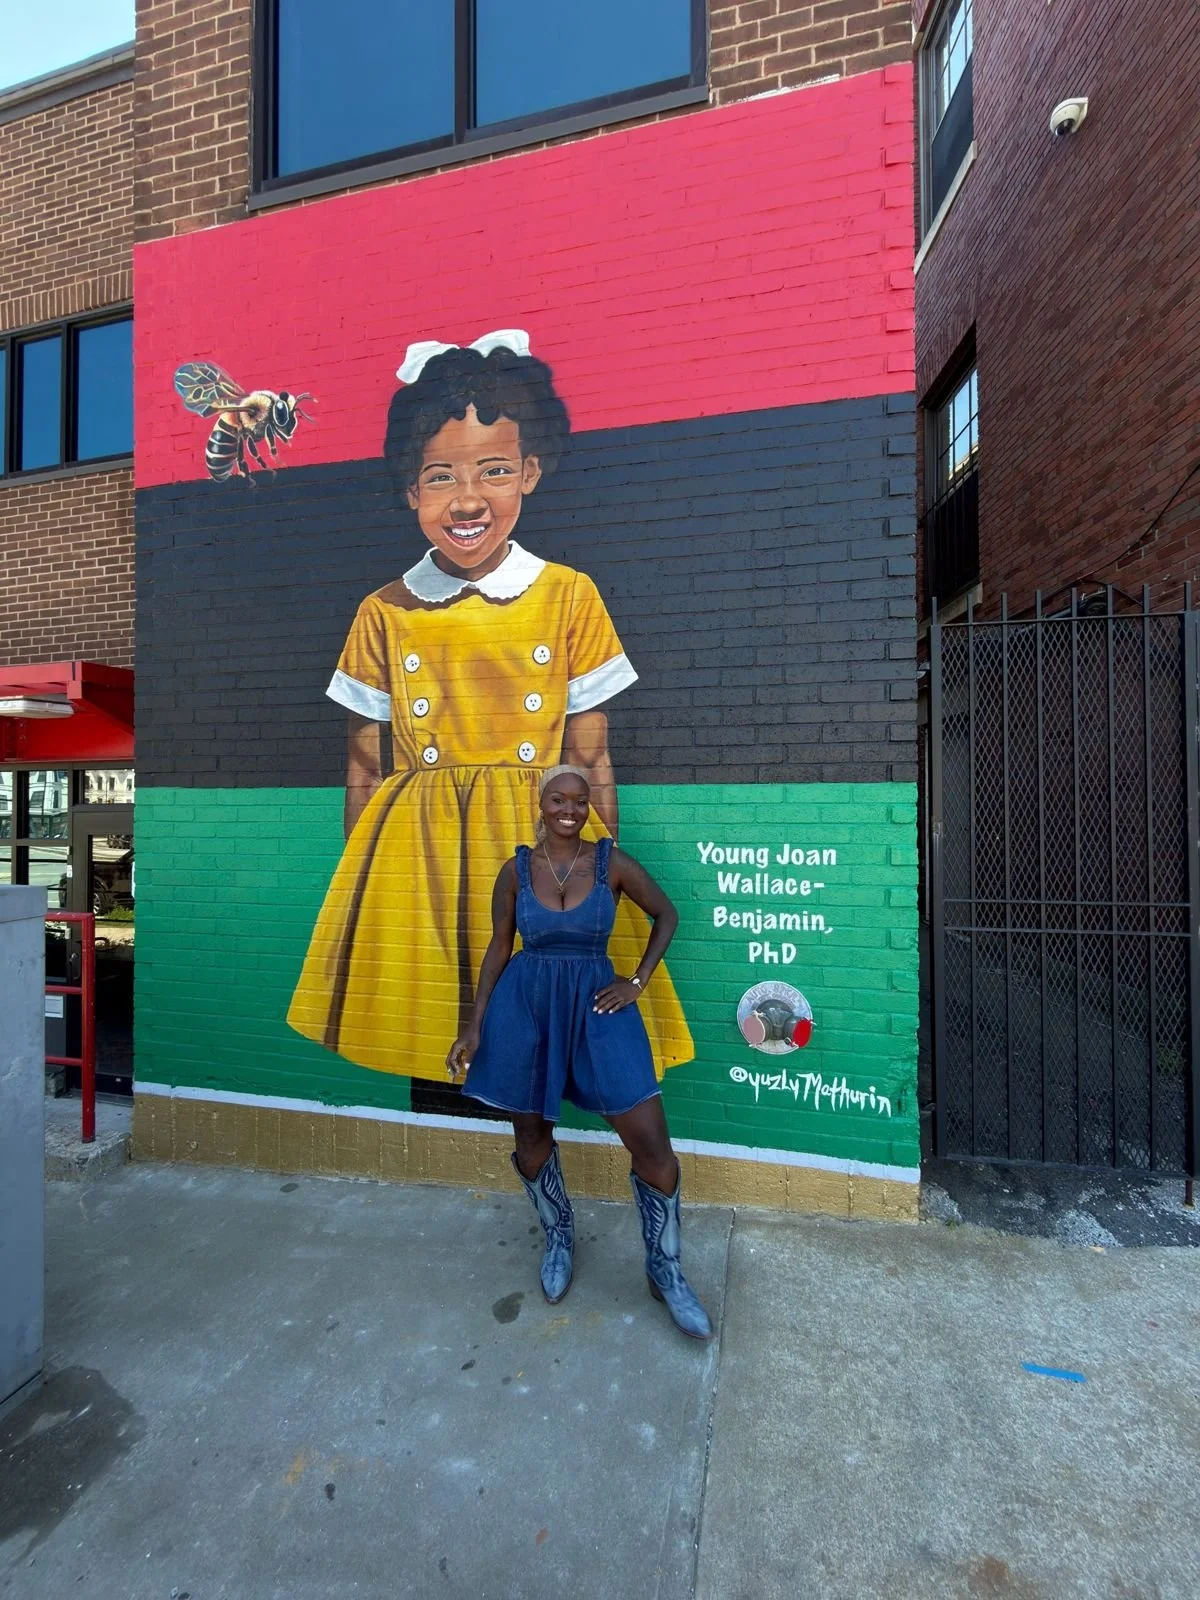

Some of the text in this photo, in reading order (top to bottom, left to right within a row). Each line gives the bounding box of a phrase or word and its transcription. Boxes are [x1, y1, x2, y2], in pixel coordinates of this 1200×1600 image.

[696, 841, 838, 869] Young Joan
[717, 871, 825, 897] Wallace-
[713, 905, 834, 935] Benjamin,
[748, 941, 797, 965] PhD
